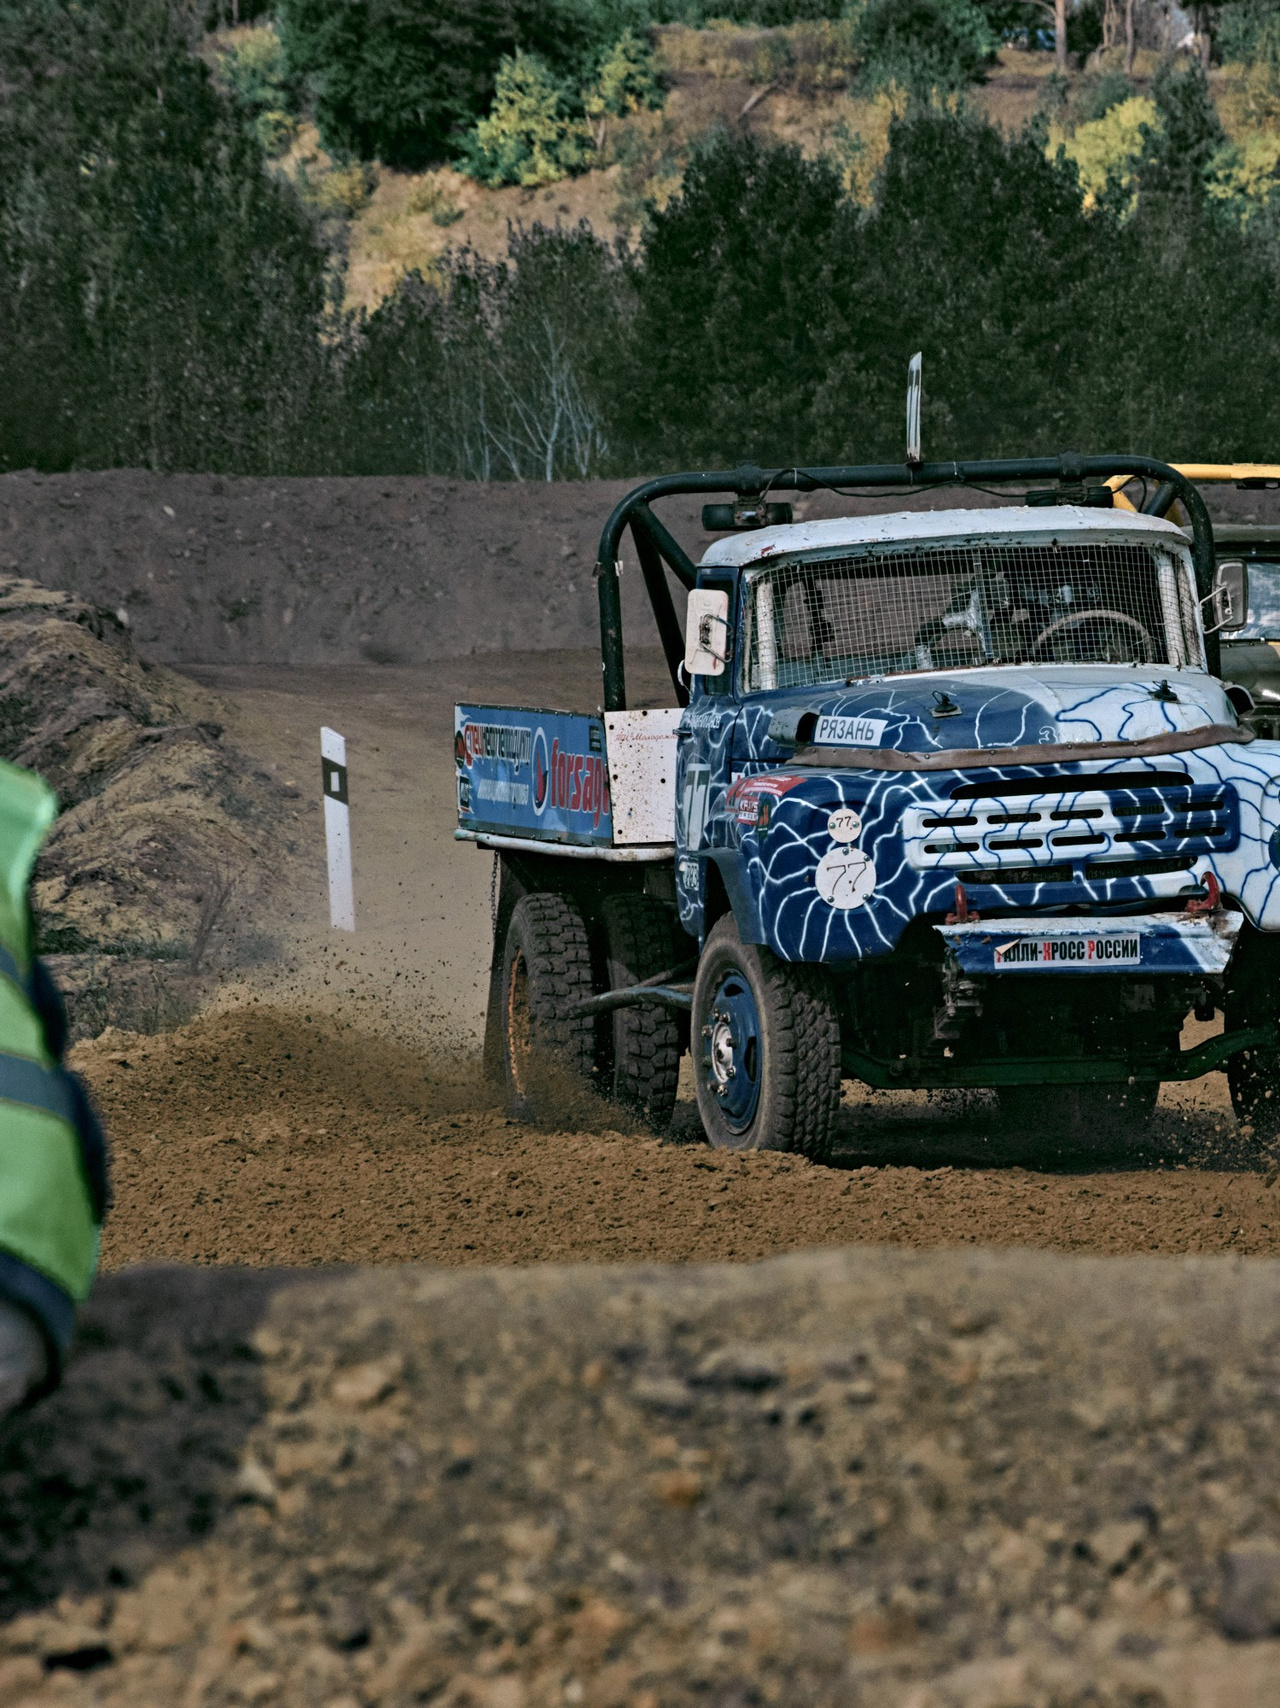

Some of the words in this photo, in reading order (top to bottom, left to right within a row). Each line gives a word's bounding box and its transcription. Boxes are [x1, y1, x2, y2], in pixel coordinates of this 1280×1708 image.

[820, 718, 875, 742] РЯЗАНЬ
[836, 817, 852, 829] 77
[826, 862, 868, 895] 77
[1087, 938, 1138, 960] РОССИИ
